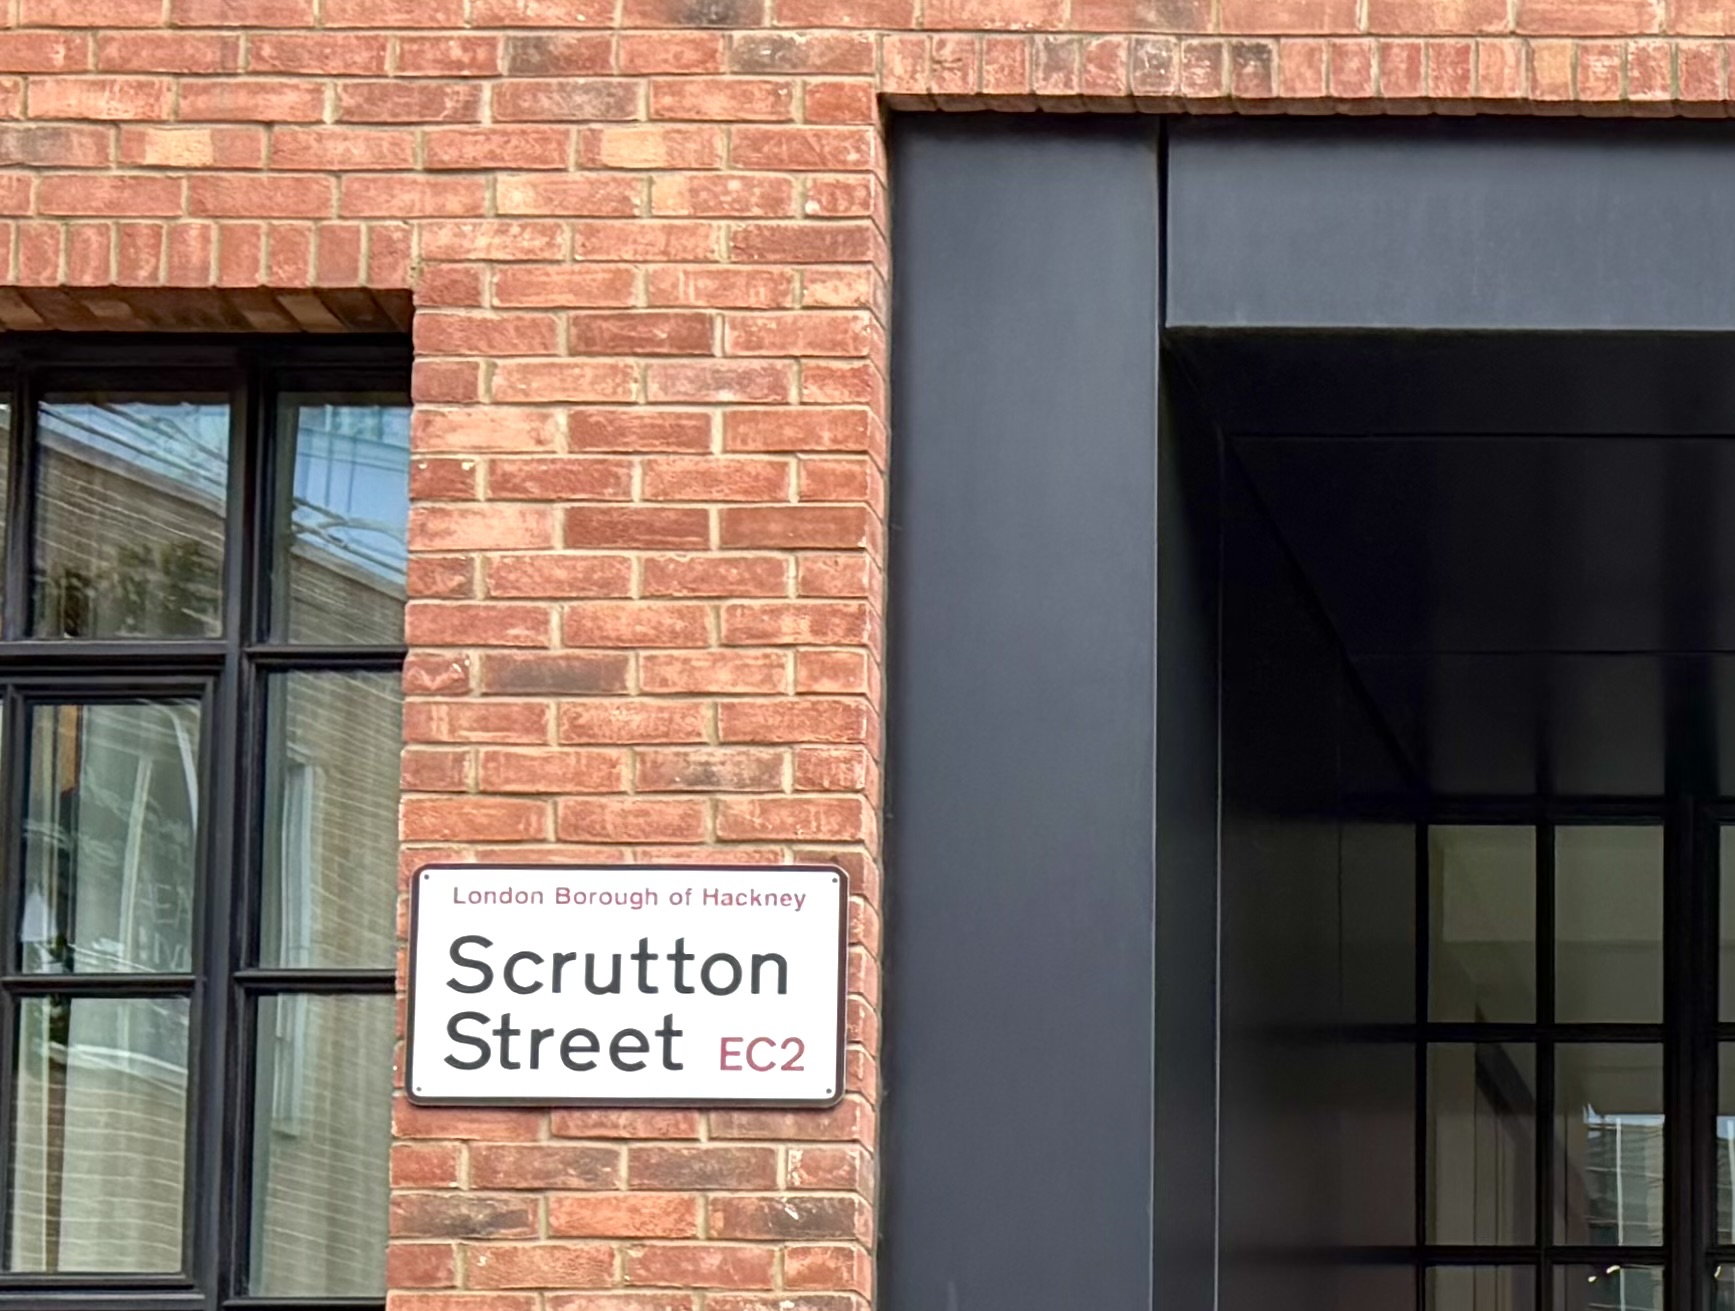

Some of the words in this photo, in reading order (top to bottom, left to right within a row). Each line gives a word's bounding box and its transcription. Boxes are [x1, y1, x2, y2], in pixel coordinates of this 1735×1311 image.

[453, 887, 543, 905] London
[555, 887, 658, 910] Borough
[669, 887, 693, 906] of
[702, 888, 806, 911] Hackney
[446, 934, 788, 996] Scrutton
[444, 1010, 684, 1072] Street
[719, 1036, 806, 1072] EC2
